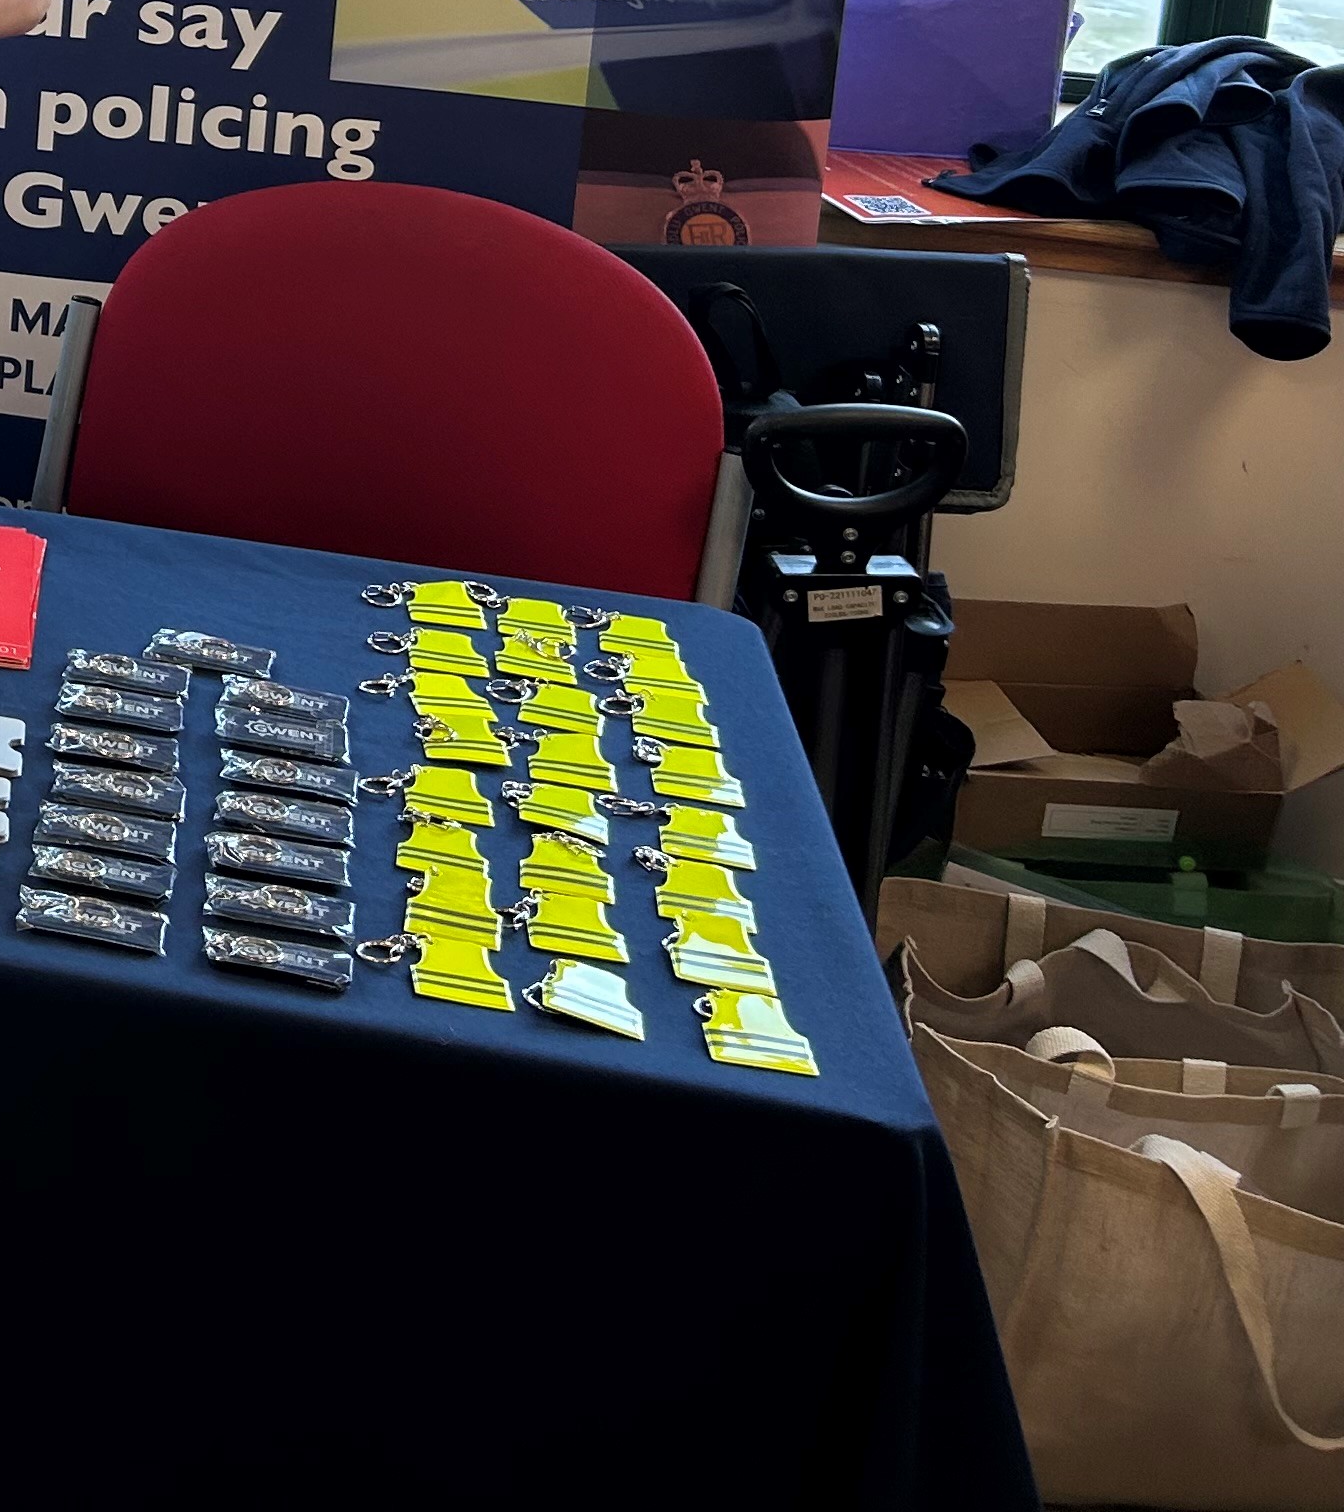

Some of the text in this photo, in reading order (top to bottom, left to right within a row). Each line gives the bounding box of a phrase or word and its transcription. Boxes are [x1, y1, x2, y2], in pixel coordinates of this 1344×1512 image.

[138, 0, 282, 70] say
[36, 85, 381, 181] policing
[4, 171, 212, 236] Gwe
[253, 724, 328, 742] GWENT
